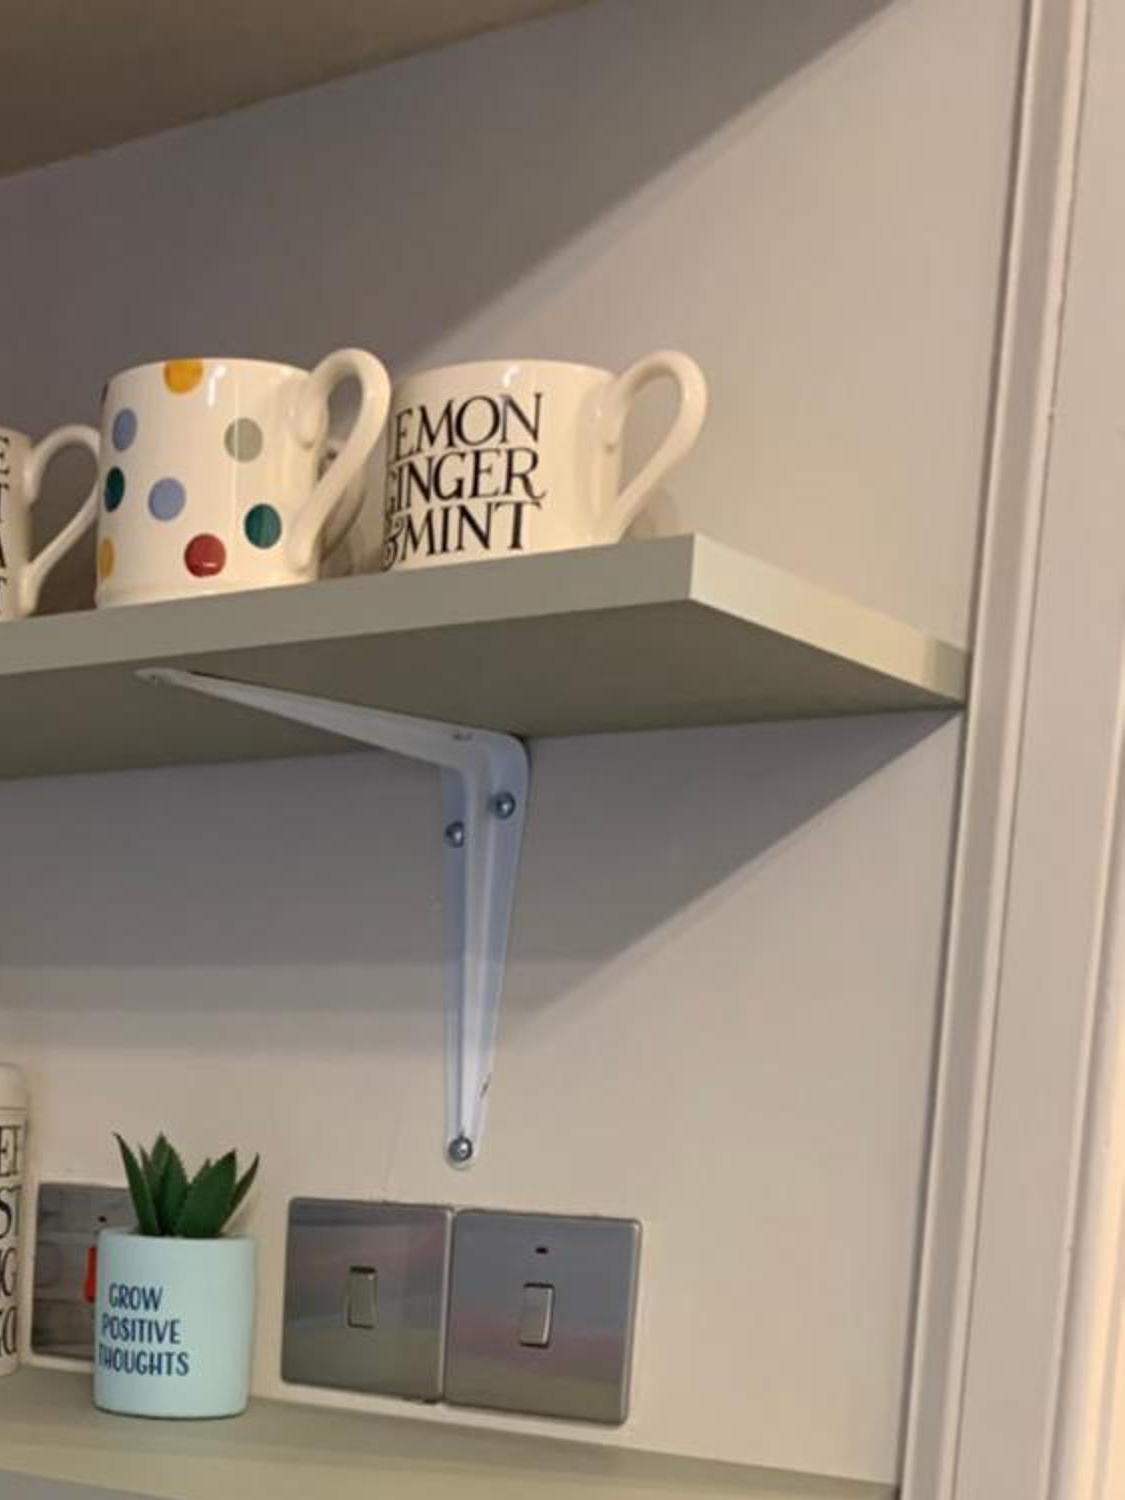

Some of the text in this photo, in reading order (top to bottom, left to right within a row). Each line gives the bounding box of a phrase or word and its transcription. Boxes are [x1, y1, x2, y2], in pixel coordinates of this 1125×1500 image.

[394, 392, 542, 462] EMON
[108, 1283, 163, 1311] GROW
[102, 1312, 181, 1345] POSITIVE
[99, 1341, 190, 1376] THOUGHTS
